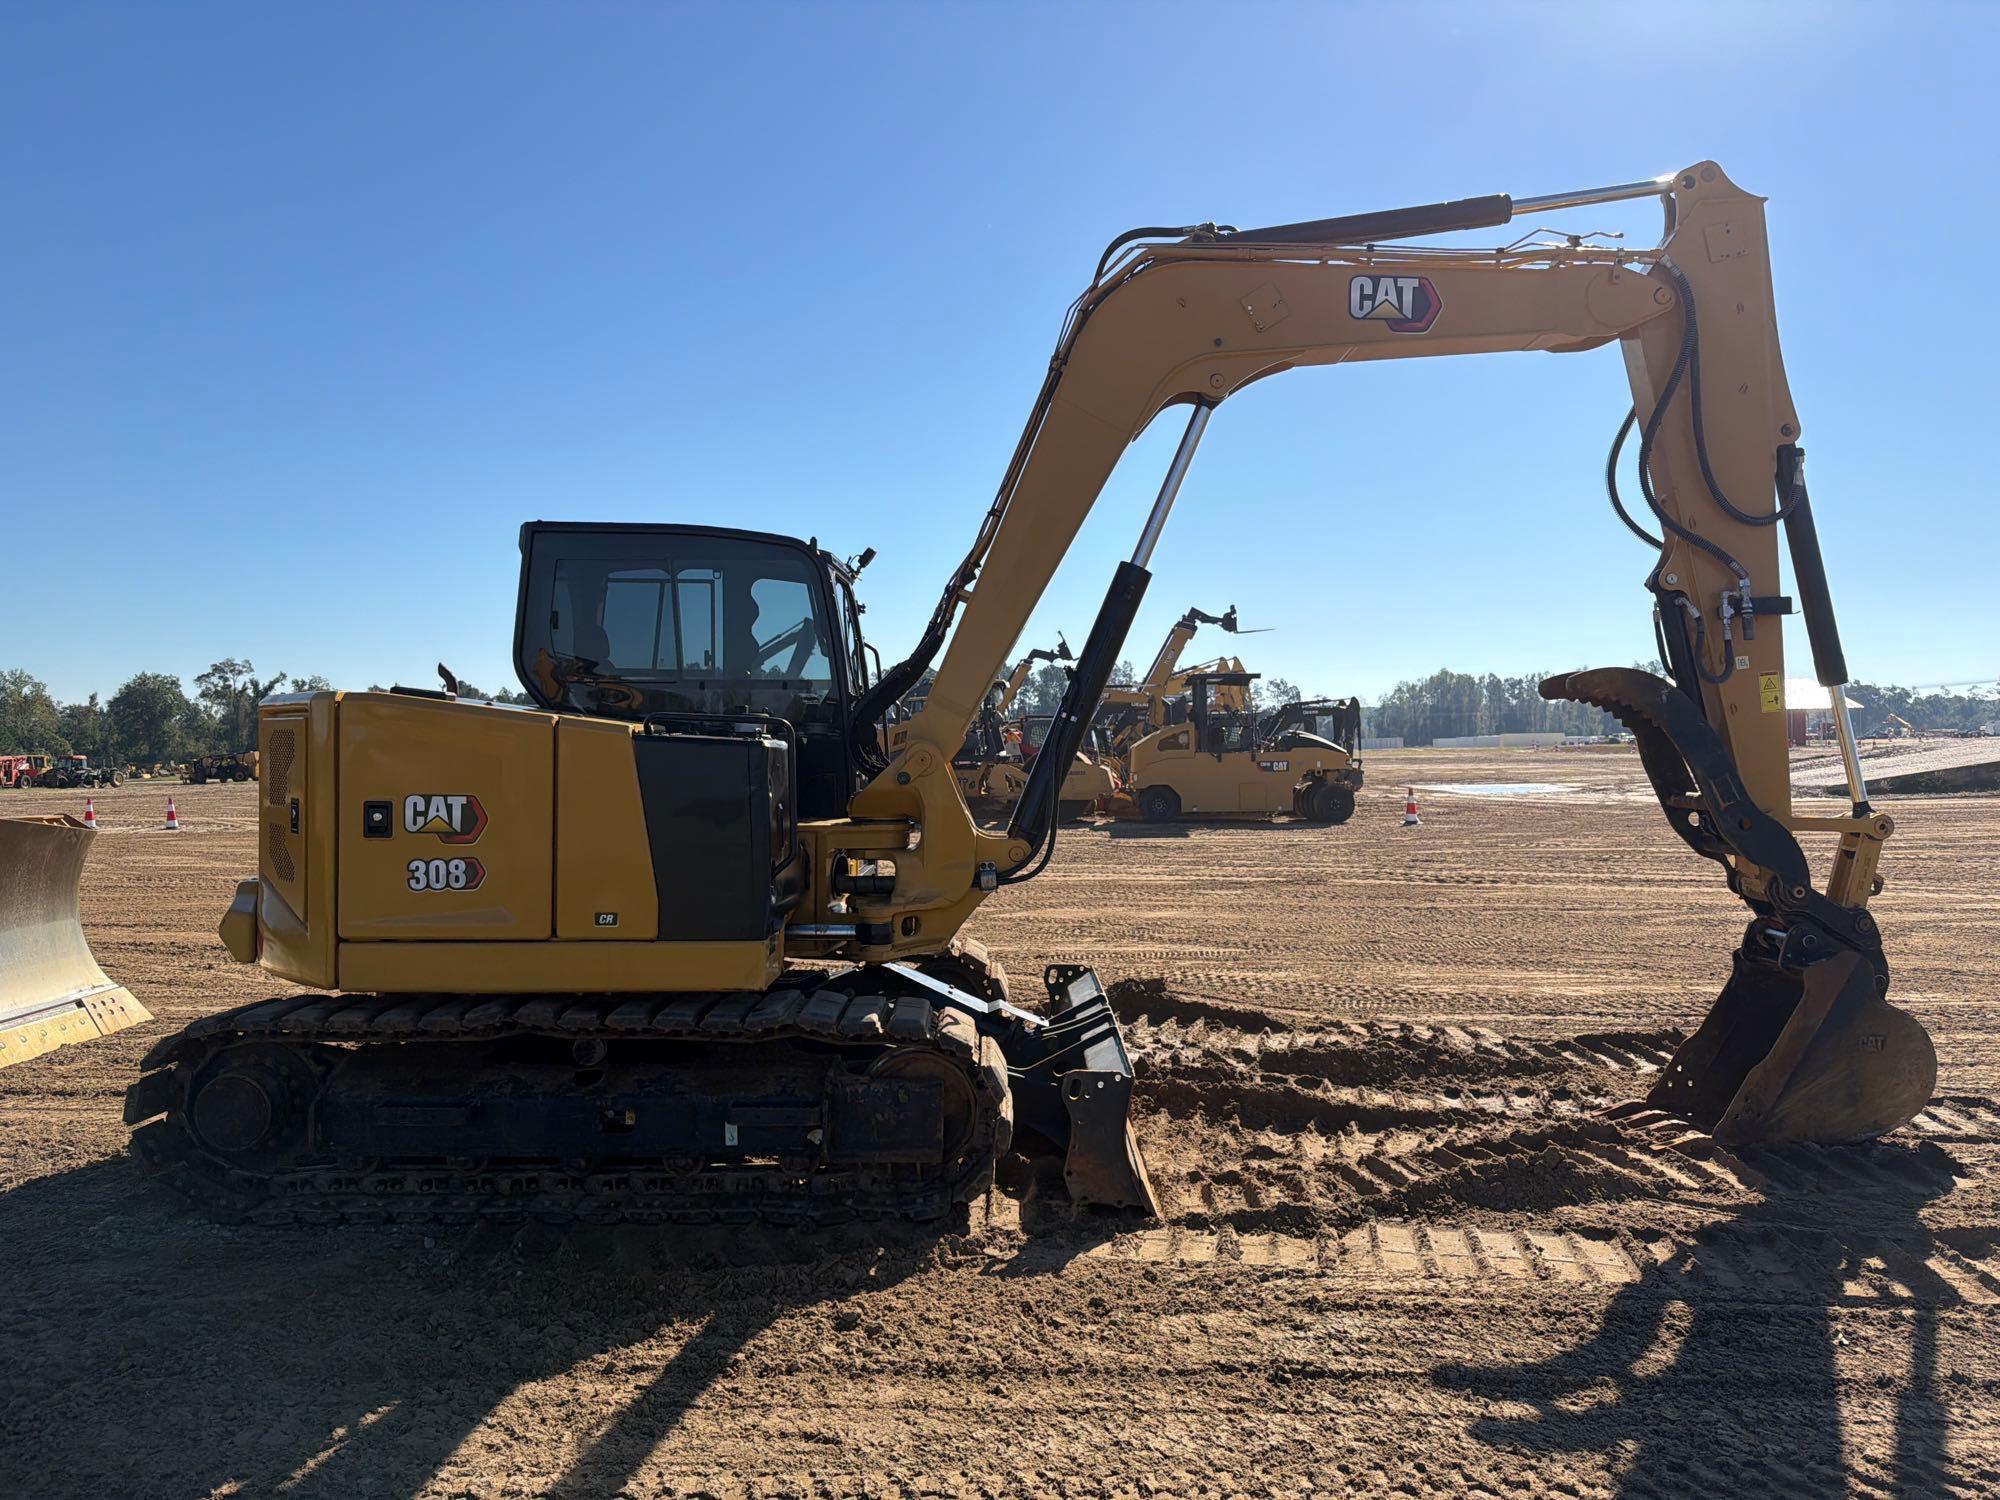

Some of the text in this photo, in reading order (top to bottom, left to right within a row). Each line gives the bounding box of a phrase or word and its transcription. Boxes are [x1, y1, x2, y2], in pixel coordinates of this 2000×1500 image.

[1350, 276, 1419, 319] CAT
[1272, 761, 1288, 771] CAT
[404, 795, 467, 833] CAT
[407, 859, 467, 890] 308
[598, 914, 614, 924] CR
[1858, 1034, 1886, 1052] CAT
